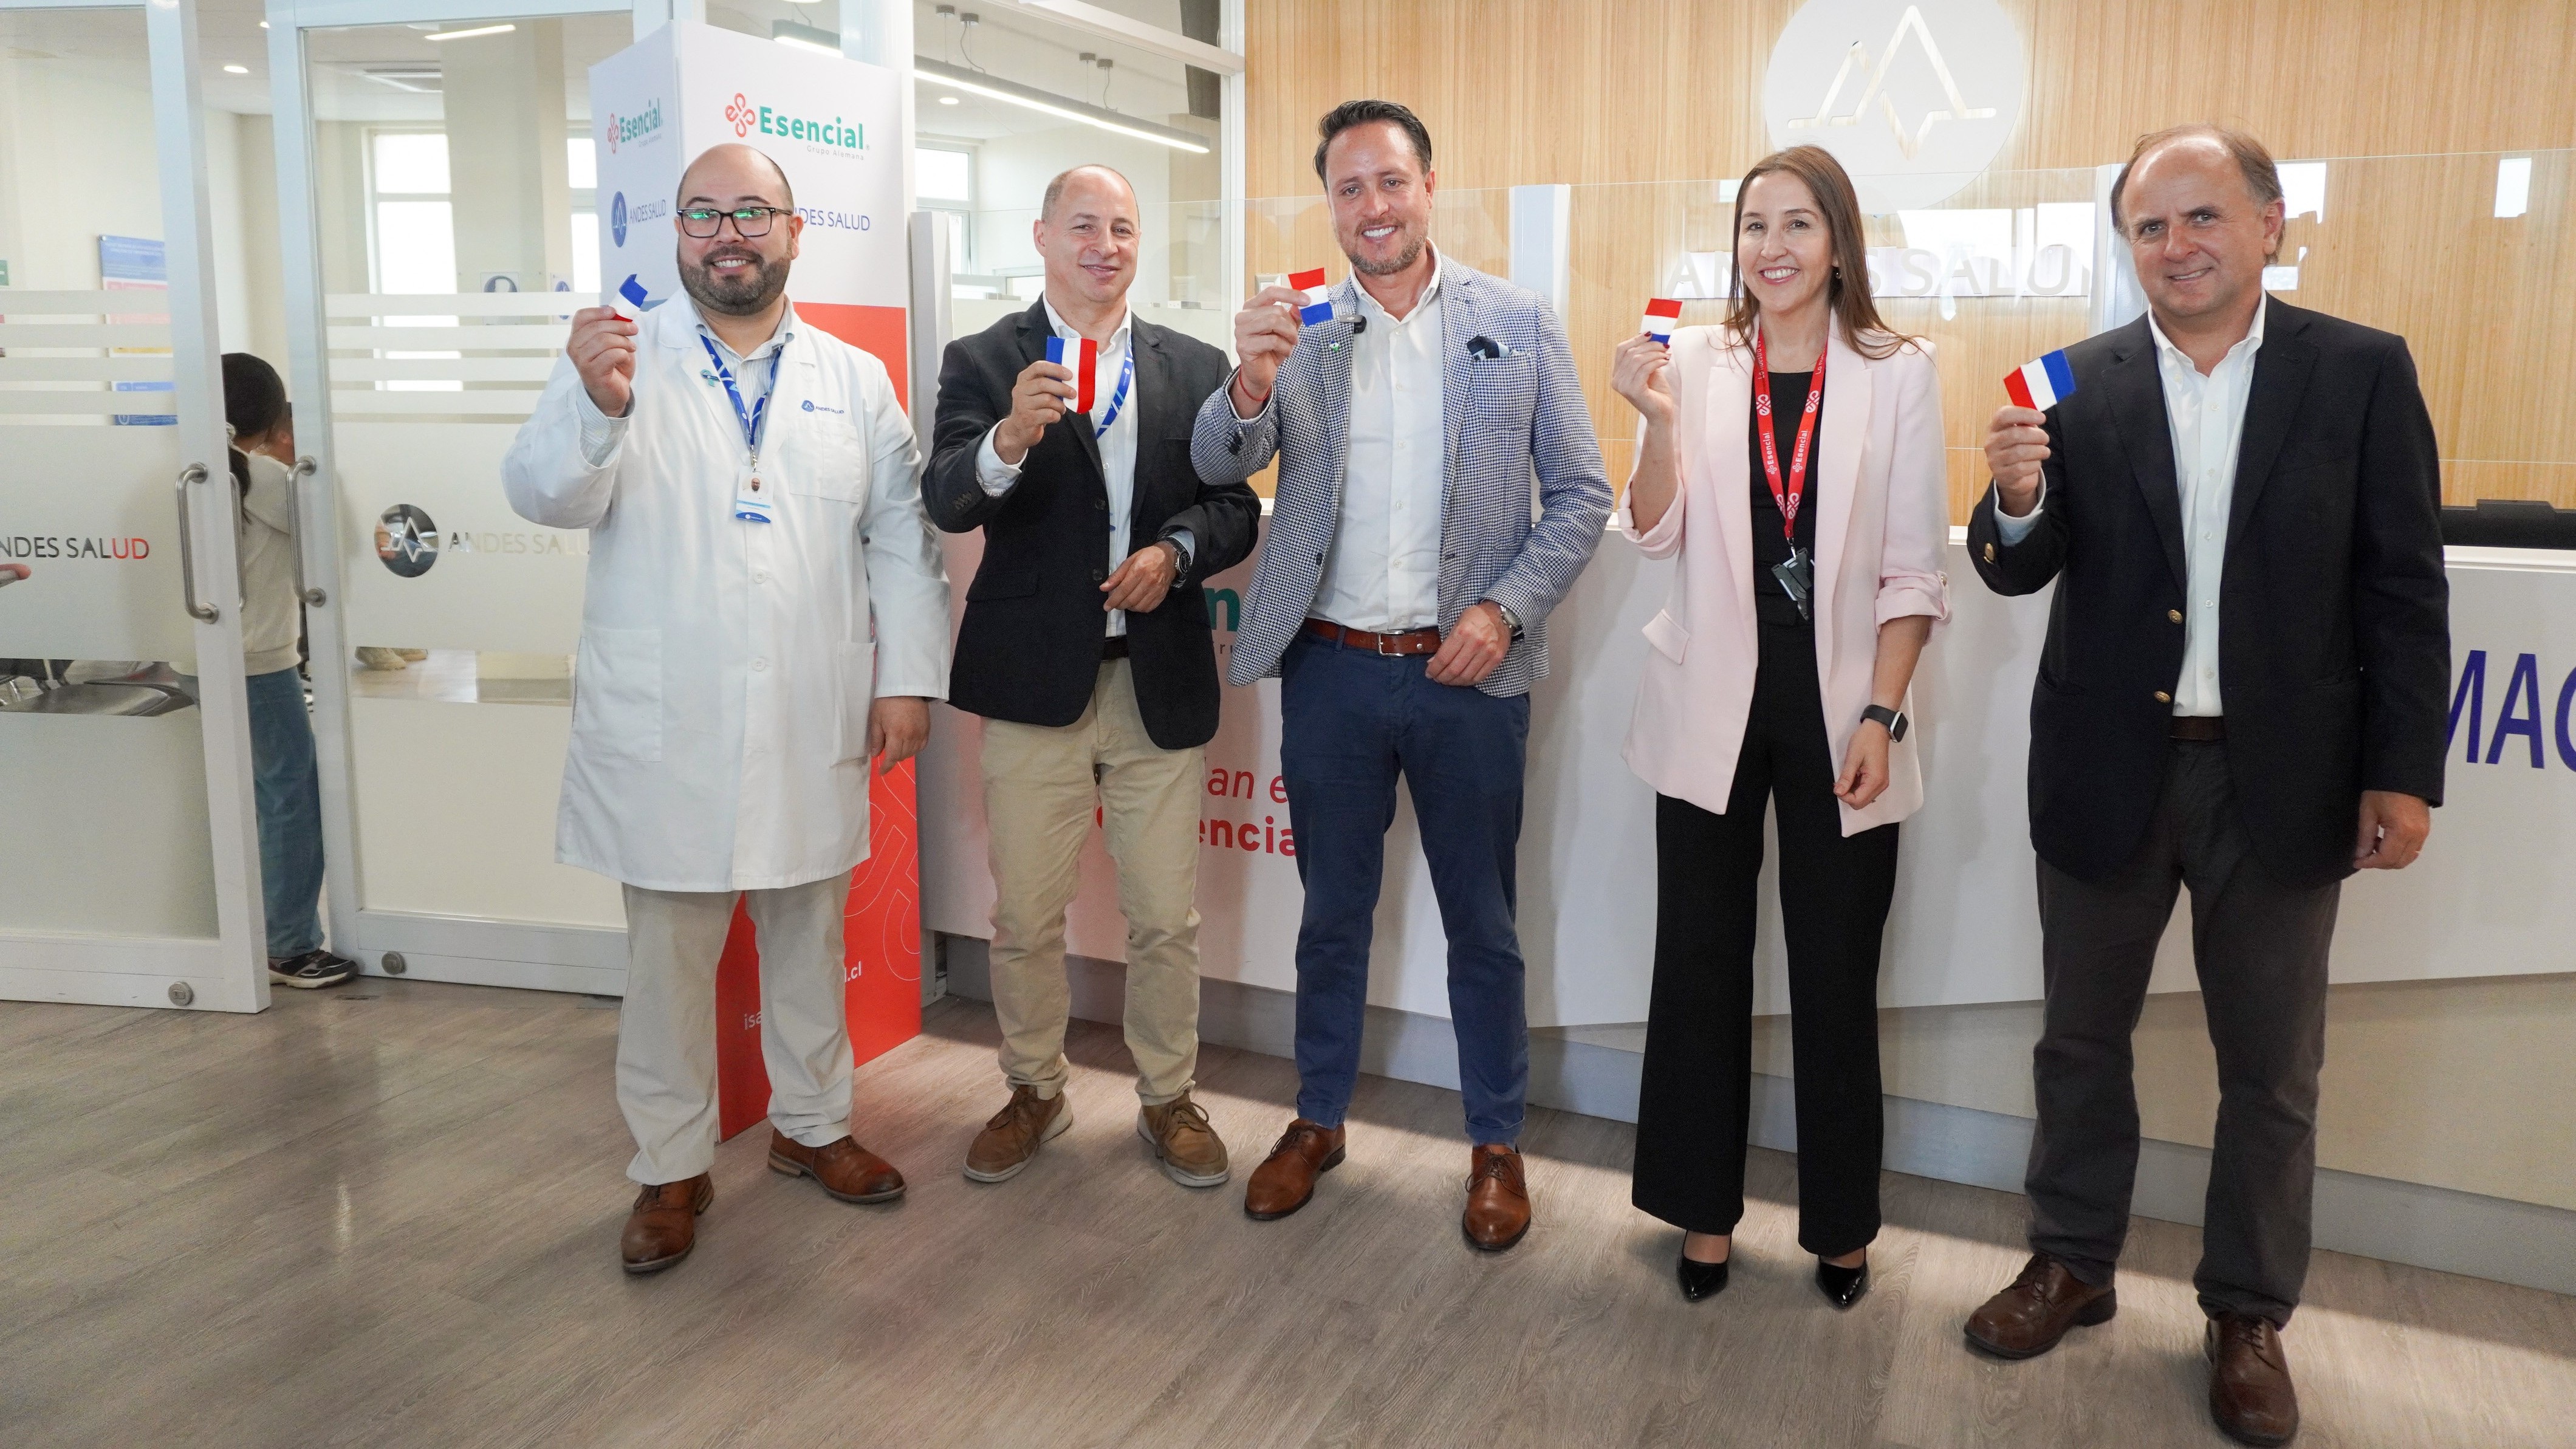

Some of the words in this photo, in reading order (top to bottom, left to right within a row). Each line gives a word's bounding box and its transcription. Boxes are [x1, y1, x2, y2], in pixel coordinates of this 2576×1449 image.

[807, 145, 830, 156] Grupo
[833, 150, 864, 160] Alemana
[629, 204, 648, 224] ANDES
[648, 199, 666, 219] SALUD
[795, 207, 824, 226] DES
[828, 211, 870, 231] SALUD
[1900, 244, 2091, 296] SALU
[66, 537, 149, 560] SALUD
[448, 532, 526, 553] ANDES
[533, 534, 590, 555] SALU
[1205, 768, 1255, 800] an
